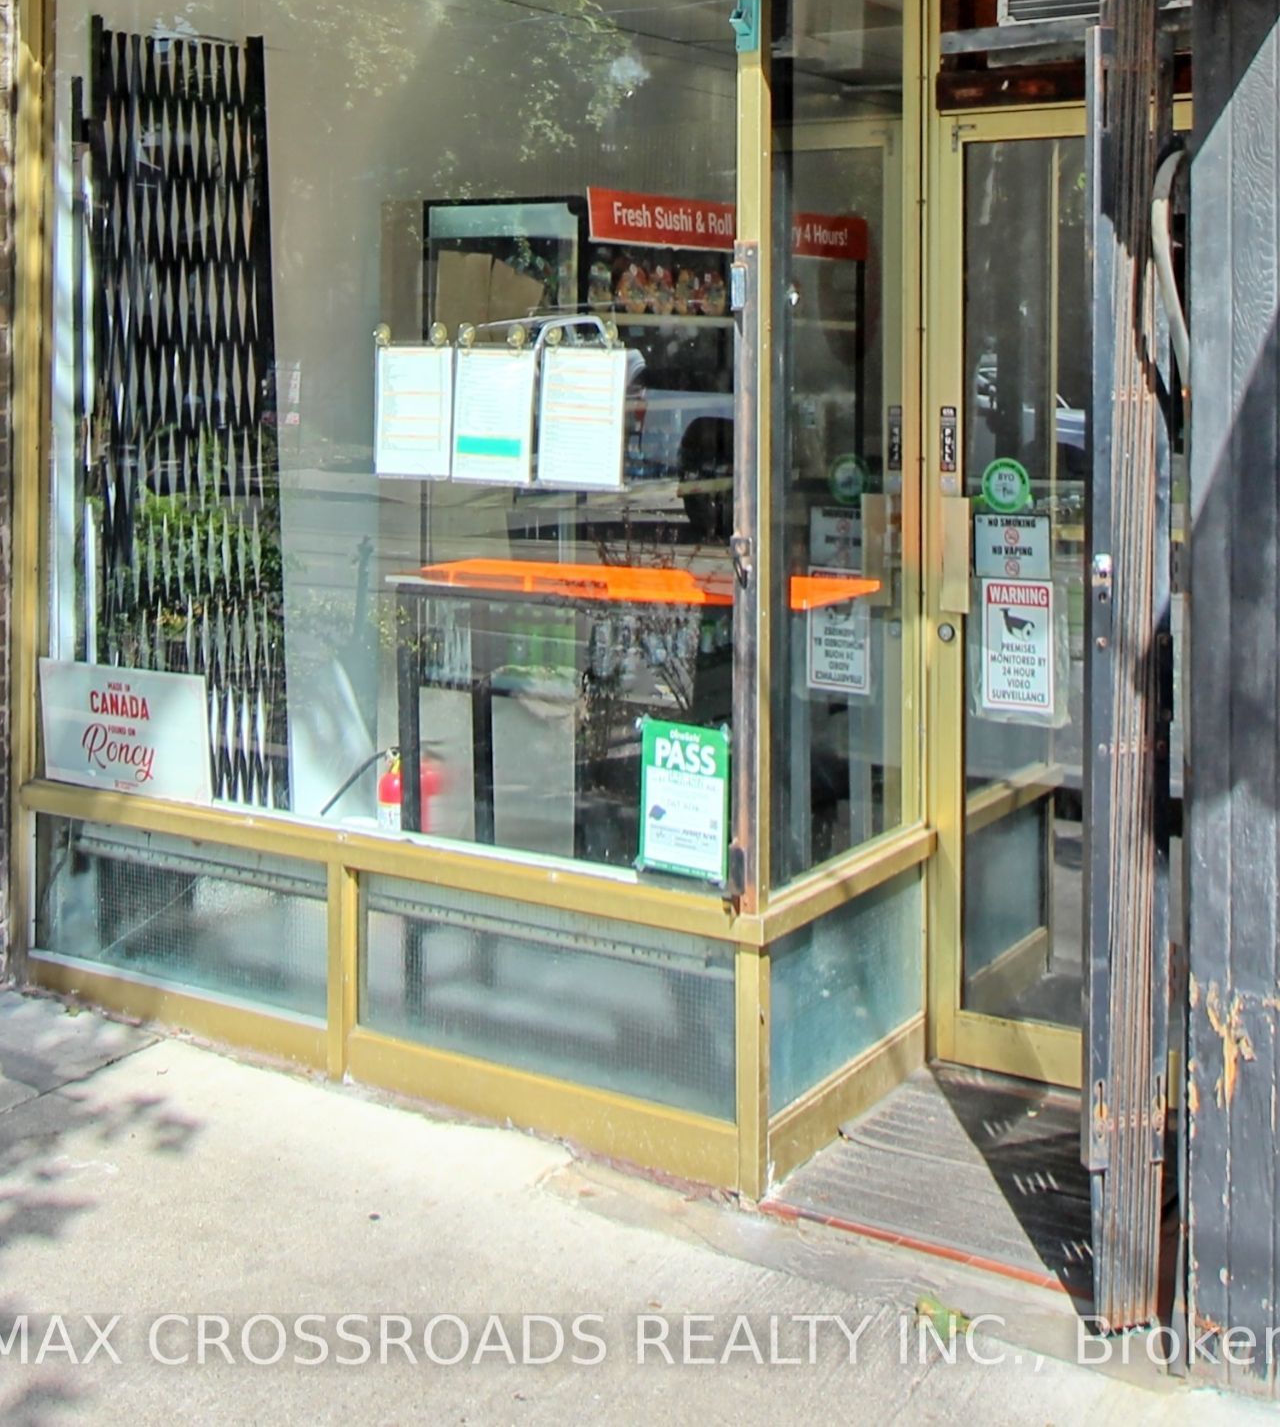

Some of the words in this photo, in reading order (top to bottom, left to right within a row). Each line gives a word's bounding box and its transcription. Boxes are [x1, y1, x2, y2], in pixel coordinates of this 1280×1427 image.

[613, 201, 652, 229] Fresh
[655, 205, 693, 233] Sushi
[696, 213, 705, 234] &
[804, 225, 813, 242] 4
[814, 226, 848, 246] Hours!
[988, 517, 999, 528] NO
[1000, 517, 1037, 529] SMOKING
[992, 545, 1003, 556] NO
[1004, 545, 1034, 557] VAPING
[988, 584, 1048, 607] WARNING
[1001, 641, 1037, 654] PREMISES
[990, 653, 1036, 666] MONITORED
[1038, 656, 1047, 667] BY
[1002, 666, 1012, 677] 24
[1013, 667, 1036, 679] HOUR
[1006, 678, 1032, 690] VIDEO
[991, 688, 1047, 704] SURVEILLANCE
[89, 690, 151, 721] CANADA
[81, 722, 155, 783] Roncy
[654, 736, 716, 776] PASS
